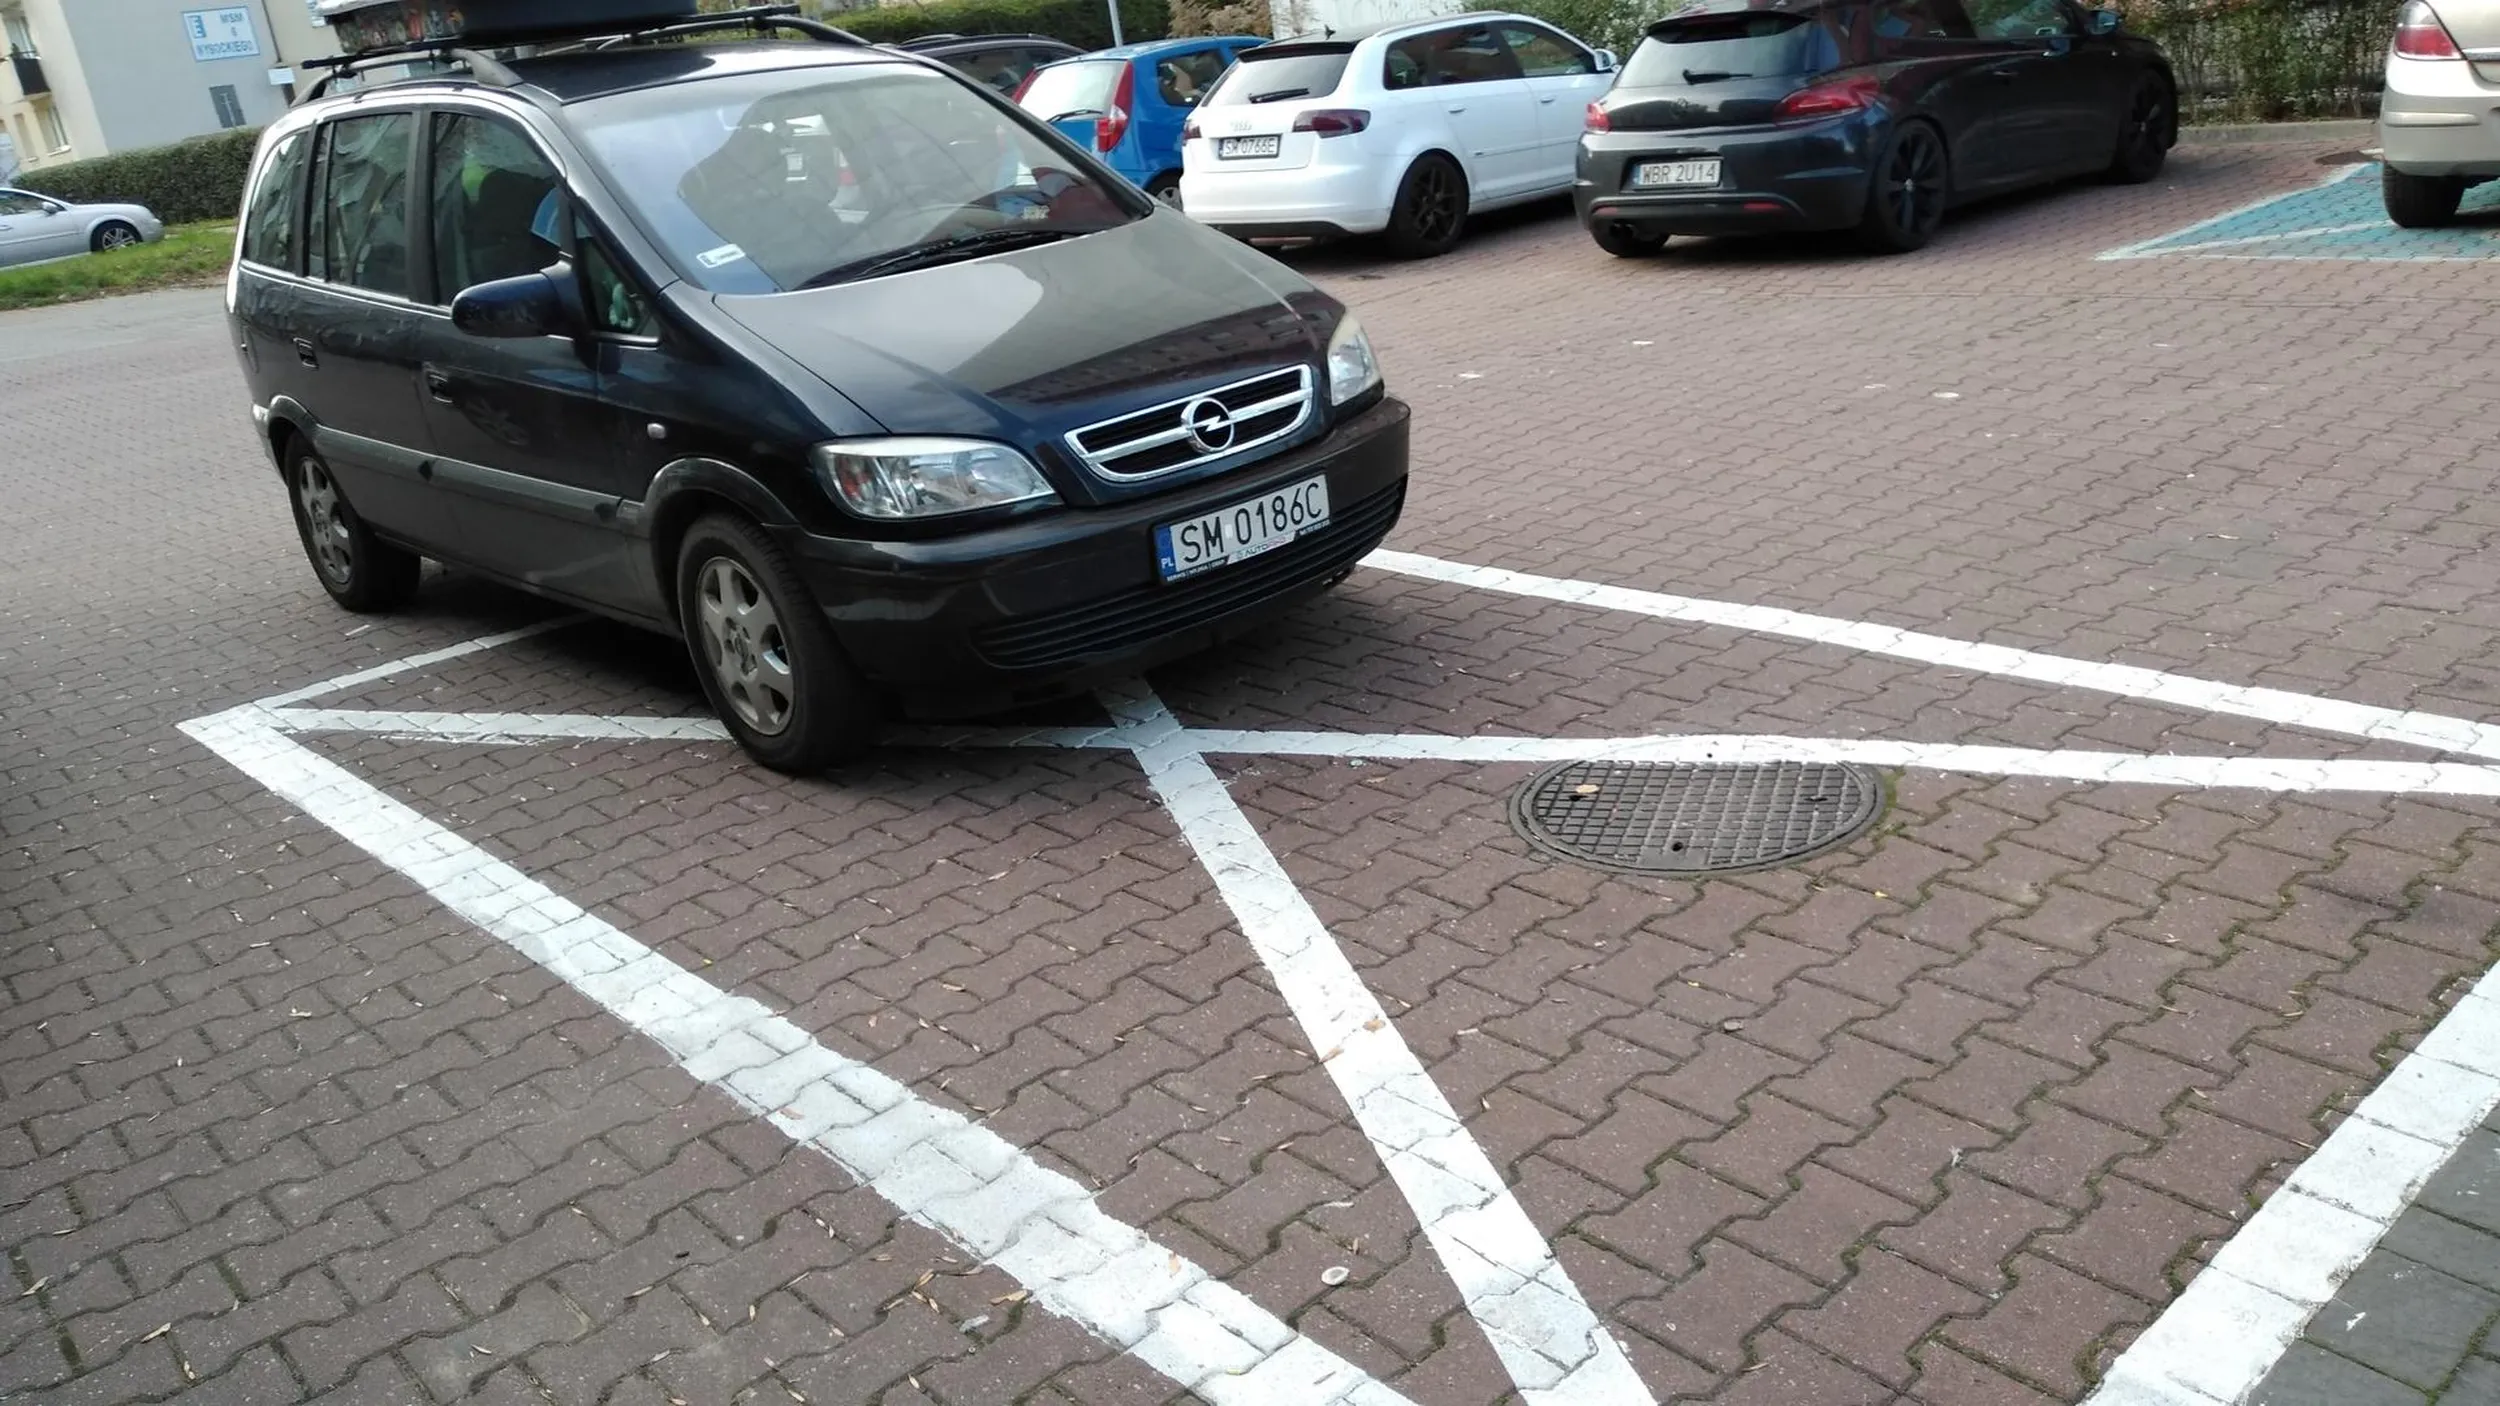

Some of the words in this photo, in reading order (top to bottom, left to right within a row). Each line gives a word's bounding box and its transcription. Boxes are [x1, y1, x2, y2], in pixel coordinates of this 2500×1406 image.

[1241, 138, 1275, 154] 0766E
[1642, 165, 1670, 183] WBR
[1676, 163, 1716, 182] 2U14
[1180, 516, 1225, 564] SM
[1234, 482, 1323, 546] 0186C
[1161, 558, 1174, 569] PL
